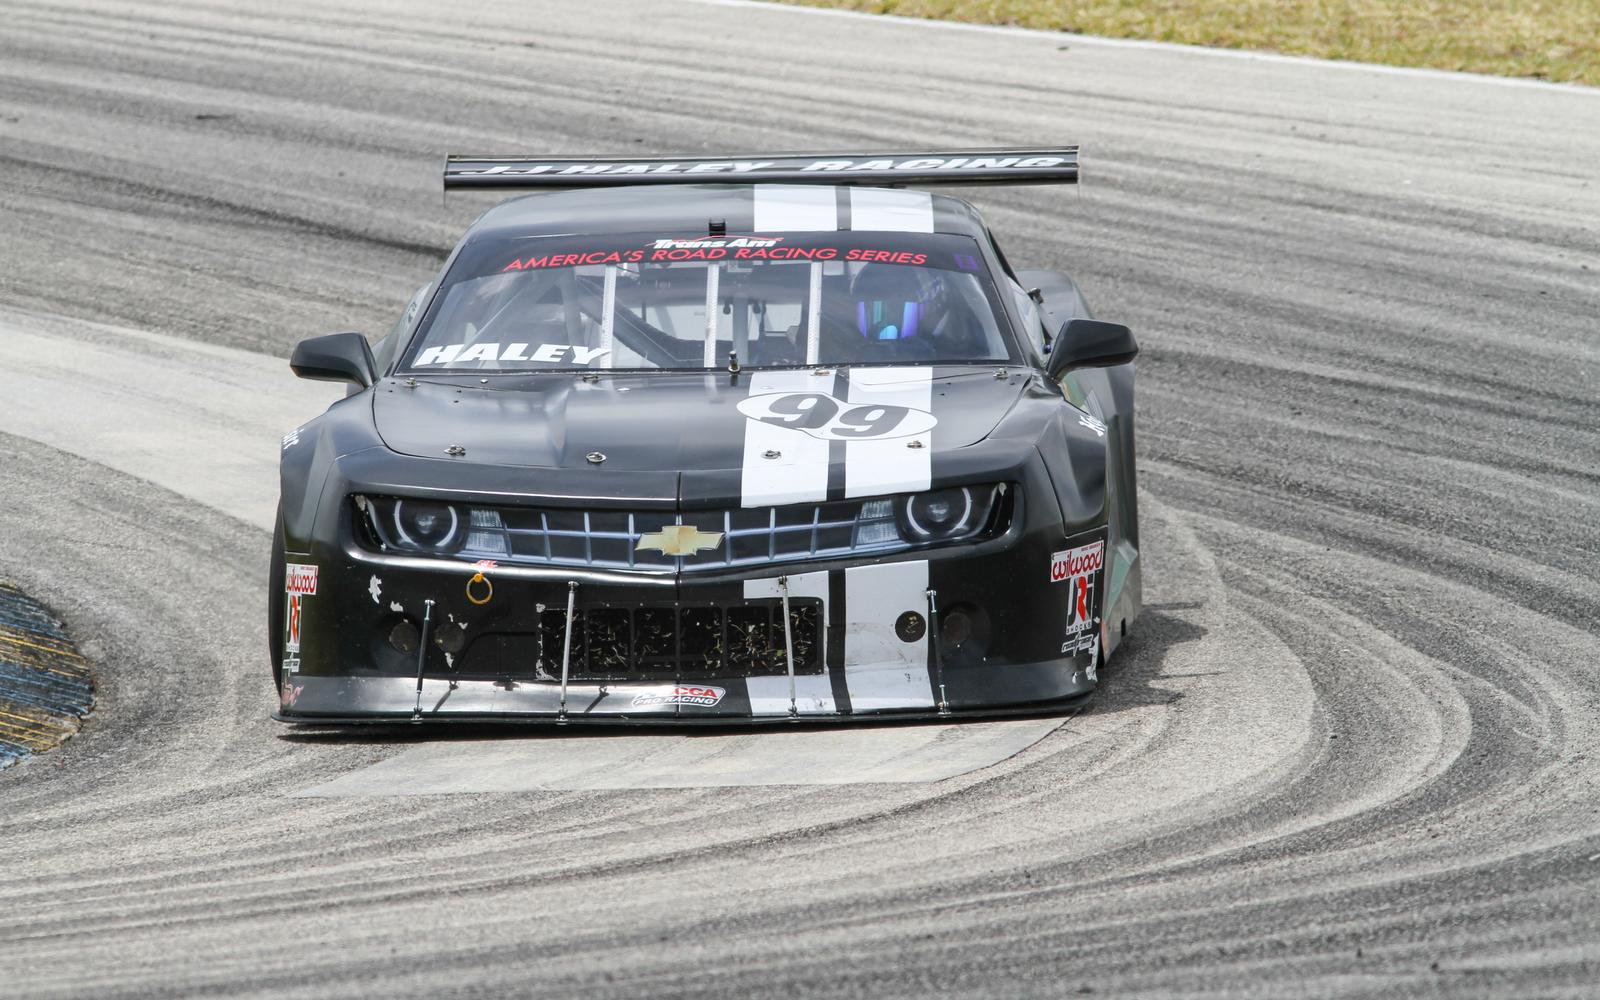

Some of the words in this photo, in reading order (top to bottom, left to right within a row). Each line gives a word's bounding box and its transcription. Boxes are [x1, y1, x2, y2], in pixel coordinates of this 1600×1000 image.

[555, 162, 776, 175] HALEY
[801, 157, 1065, 171] RACING
[653, 239, 727, 249] Trans
[726, 238, 777, 248] Am
[502, 250, 645, 272] AMERICA'S
[651, 248, 727, 261] ROAD
[734, 247, 838, 260] RACING
[844, 249, 928, 265] SERIES
[414, 342, 612, 366] HALEY
[760, 393, 911, 438] 99
[1053, 542, 1103, 581] wilwood
[663, 696, 715, 705] RACING
